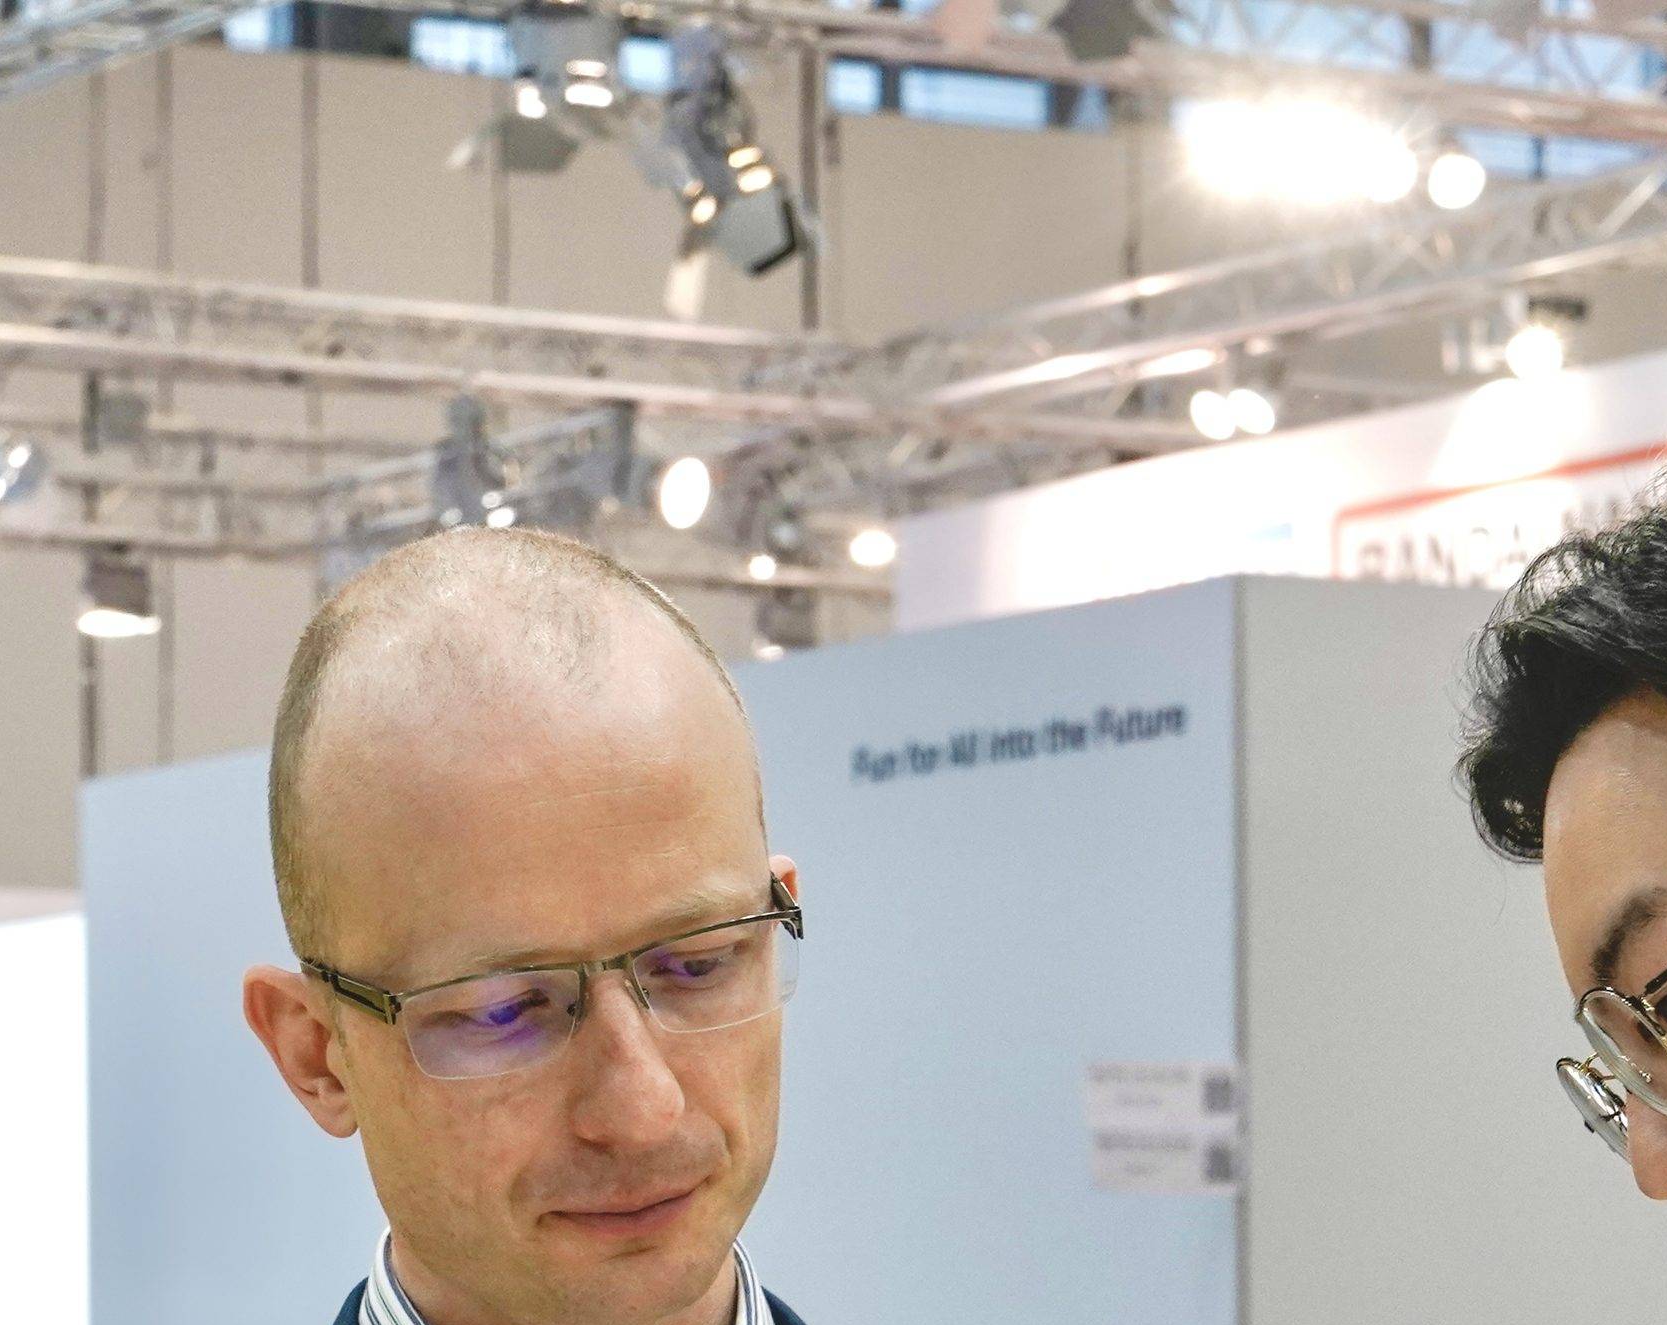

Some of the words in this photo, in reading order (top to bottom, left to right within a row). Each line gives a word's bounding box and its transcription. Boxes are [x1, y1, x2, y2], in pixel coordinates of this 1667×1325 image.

[989, 728, 1036, 763] into
[1045, 718, 1087, 753] the
[1095, 704, 1187, 744] Future
